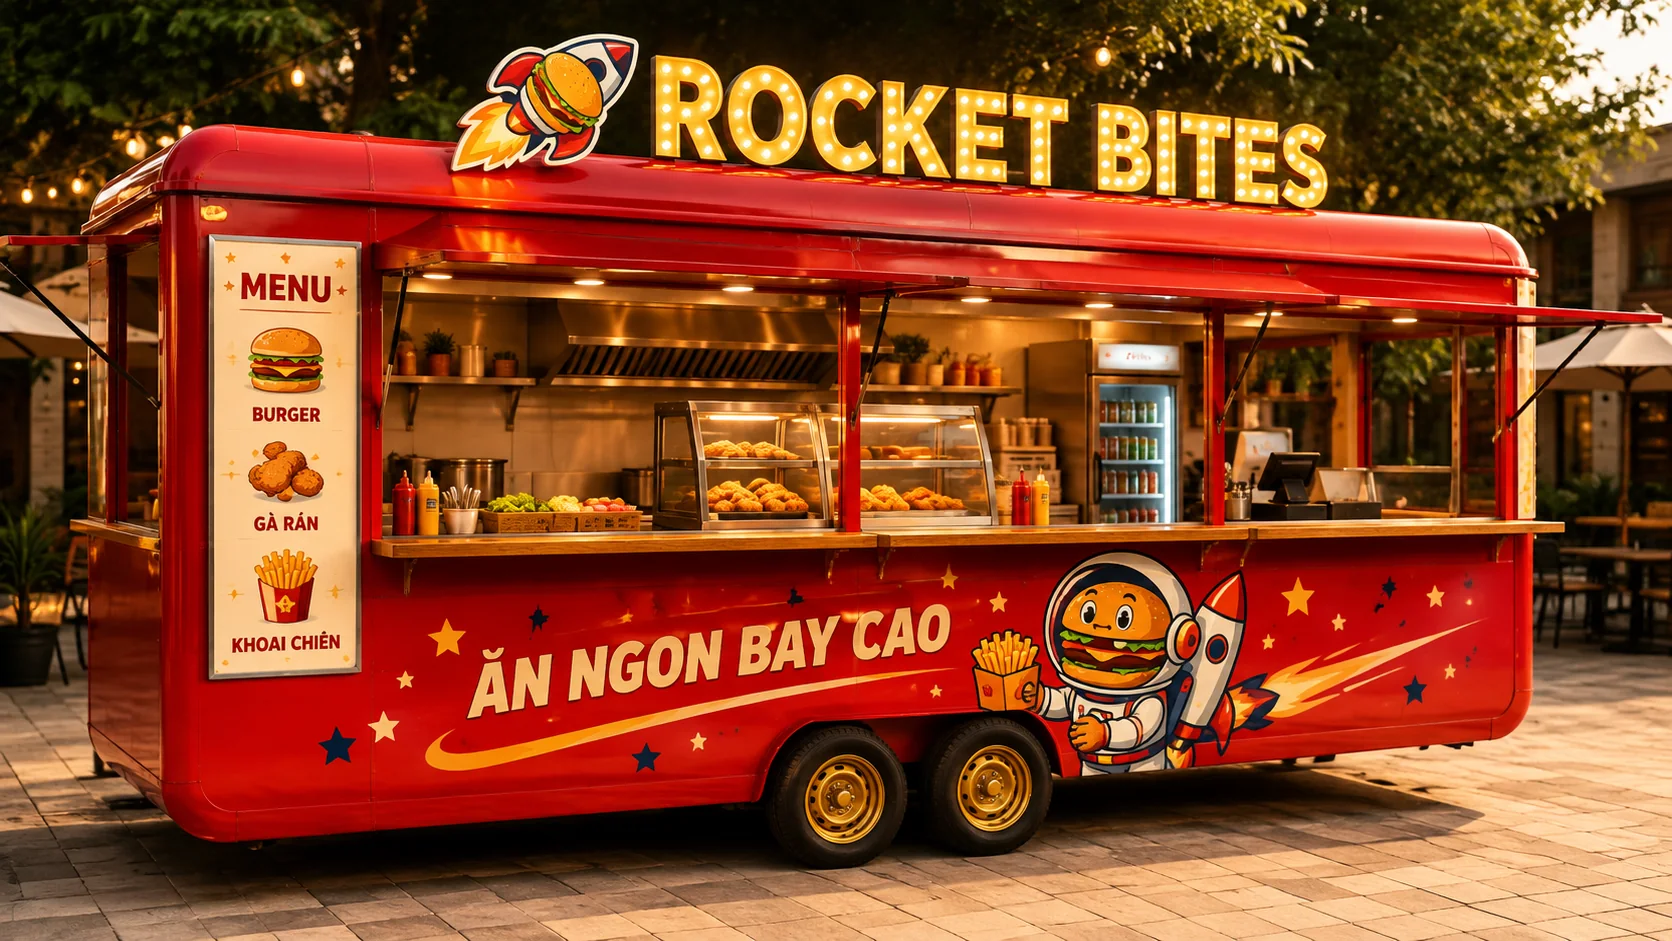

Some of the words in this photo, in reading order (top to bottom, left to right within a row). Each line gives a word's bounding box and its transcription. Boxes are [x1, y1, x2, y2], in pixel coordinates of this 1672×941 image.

[651, 54, 1069, 187] ROCKET
[1092, 102, 1328, 209] BITES
[240, 272, 332, 303] MENU
[252, 406, 321, 423] BURGER
[253, 511, 279, 532] GÀ
[283, 511, 319, 531] RÁN
[231, 636, 286, 653] KHOAI
[466, 647, 553, 719] ĂN
[568, 629, 724, 702] NGON
[737, 615, 841, 677] BAY
[852, 603, 951, 661] CAO
